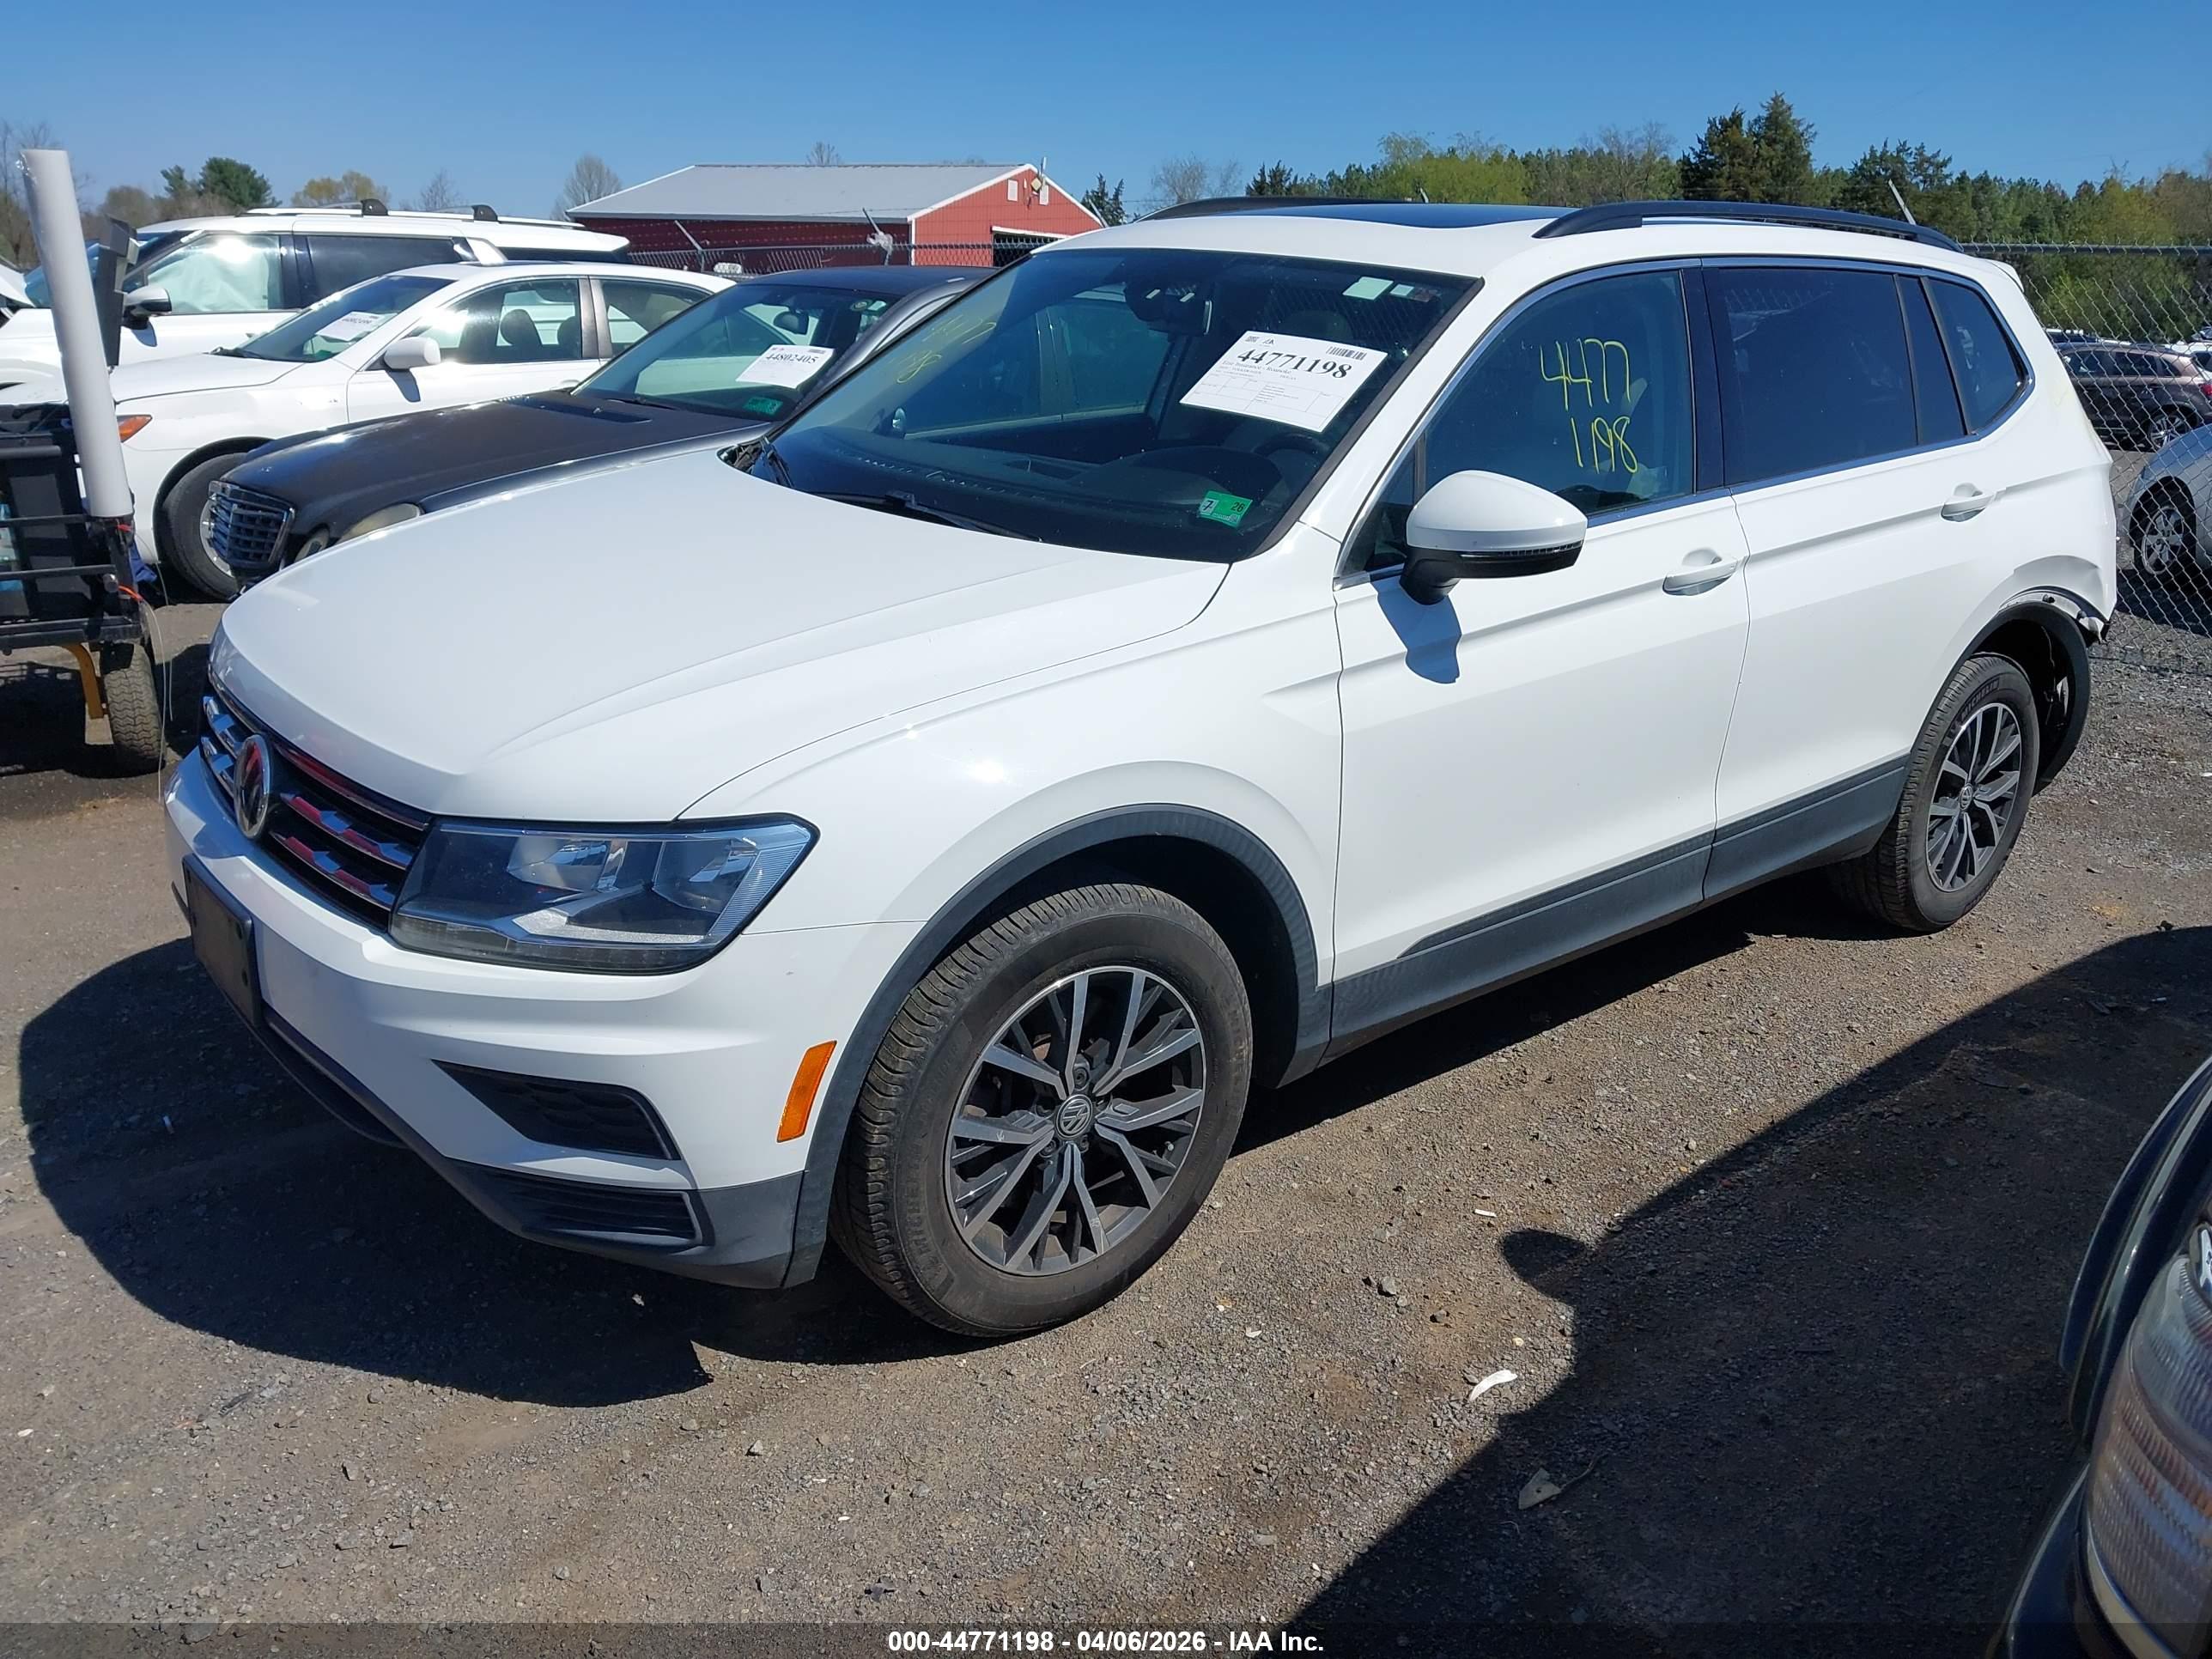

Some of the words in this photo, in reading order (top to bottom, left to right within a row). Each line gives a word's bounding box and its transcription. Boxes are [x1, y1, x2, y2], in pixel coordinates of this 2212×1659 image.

[766, 353, 819, 364] 44802405
[1237, 349, 1352, 379] 44771198
[1540, 337, 1631, 410] 4477
[1571, 416, 1638, 473] 1198
[1203, 500, 1213, 511] 7
[1231, 501, 1245, 513] 26
[1060, 1099, 1090, 1134] VW
